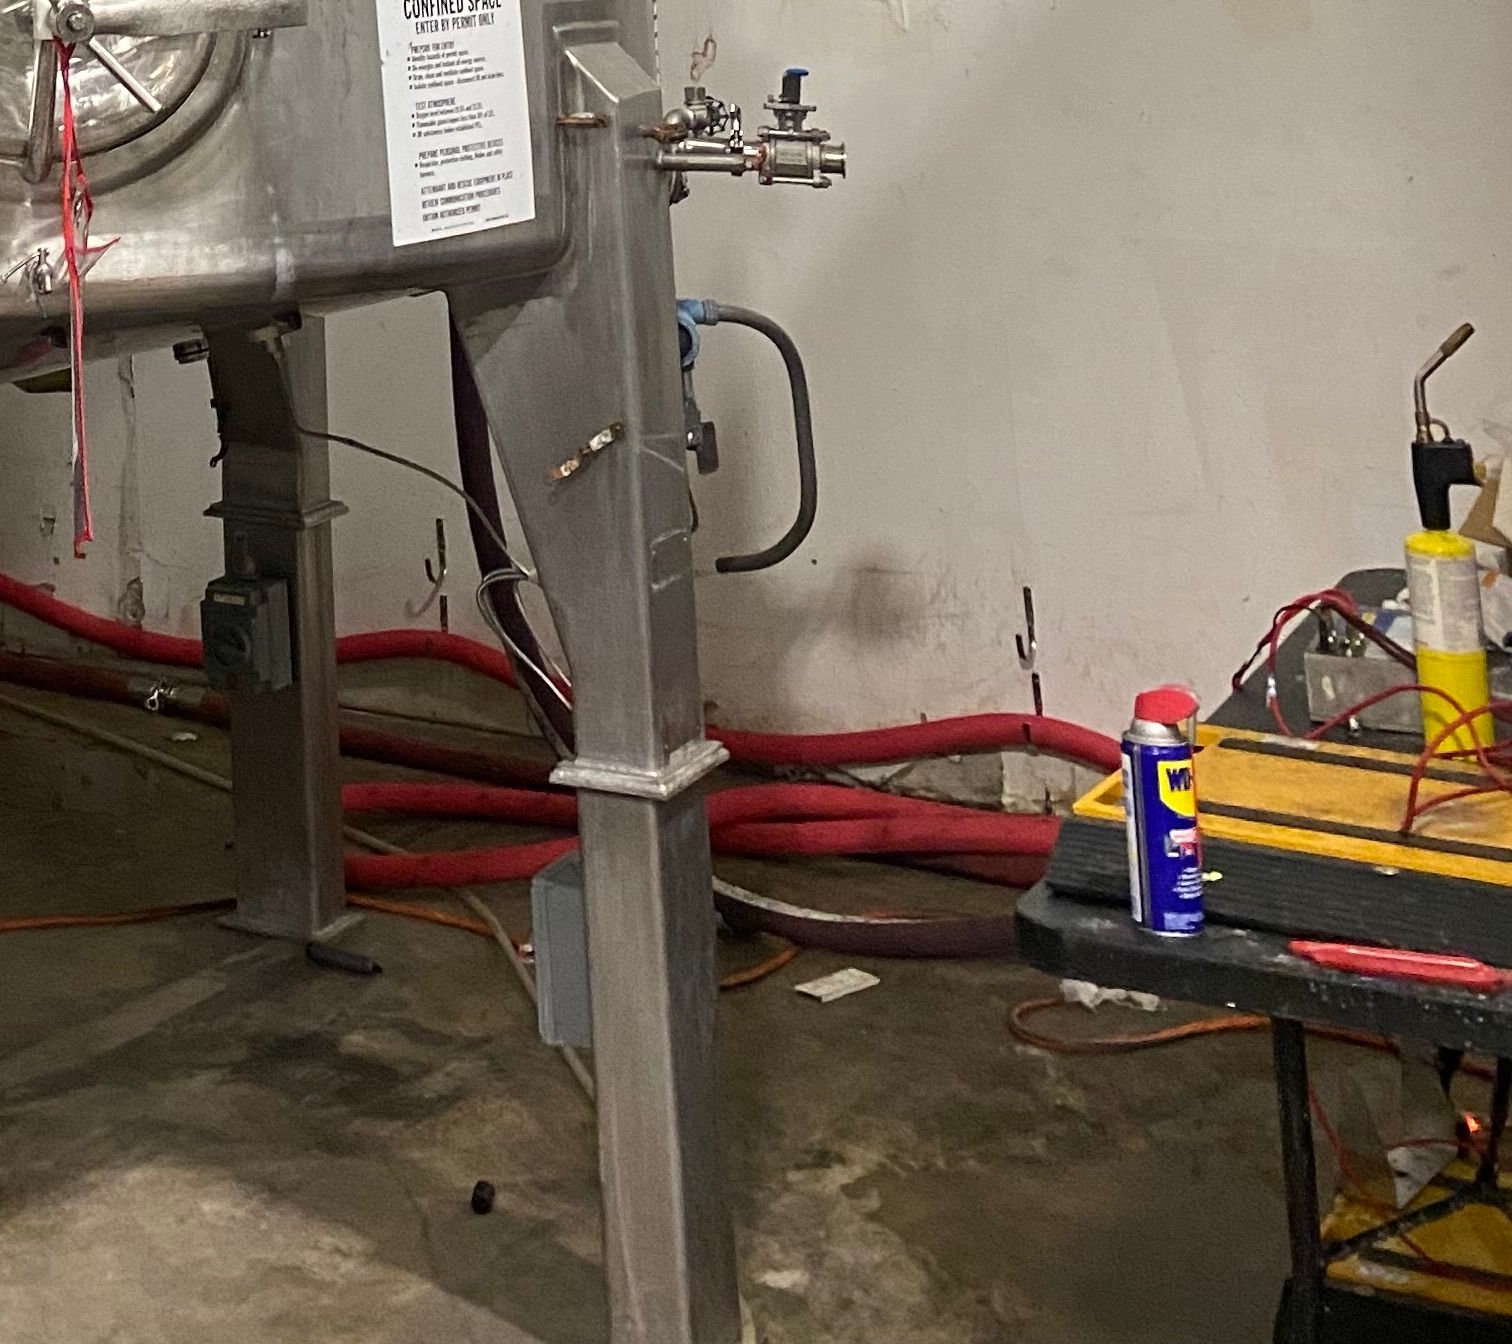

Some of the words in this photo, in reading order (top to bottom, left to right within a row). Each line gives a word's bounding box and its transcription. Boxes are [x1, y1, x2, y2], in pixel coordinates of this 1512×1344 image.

[415, 19, 439, 35] ENTER
[441, 17, 450, 31] BY
[452, 14, 477, 30] PERMIT
[478, 12, 495, 27] ONLY
